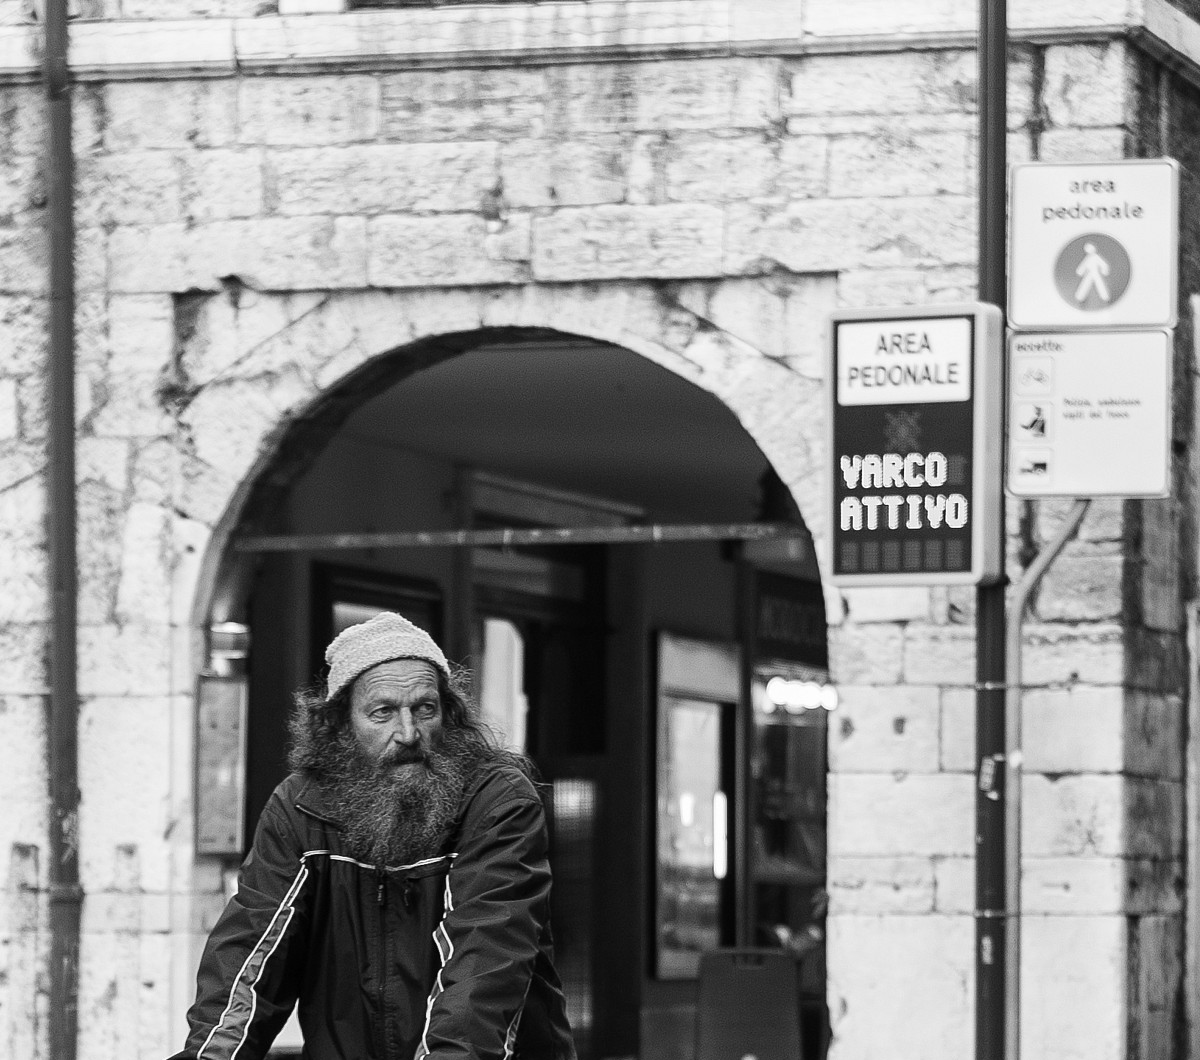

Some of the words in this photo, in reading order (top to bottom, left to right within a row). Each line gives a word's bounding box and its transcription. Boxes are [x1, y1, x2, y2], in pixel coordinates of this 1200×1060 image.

[1069, 179, 1117, 194] area
[1041, 201, 1145, 224] pedonale
[875, 331, 933, 355] AREA
[848, 362, 960, 388] PEDONALE
[840, 451, 948, 489] VARCO
[840, 493, 968, 531] ATTIVO
